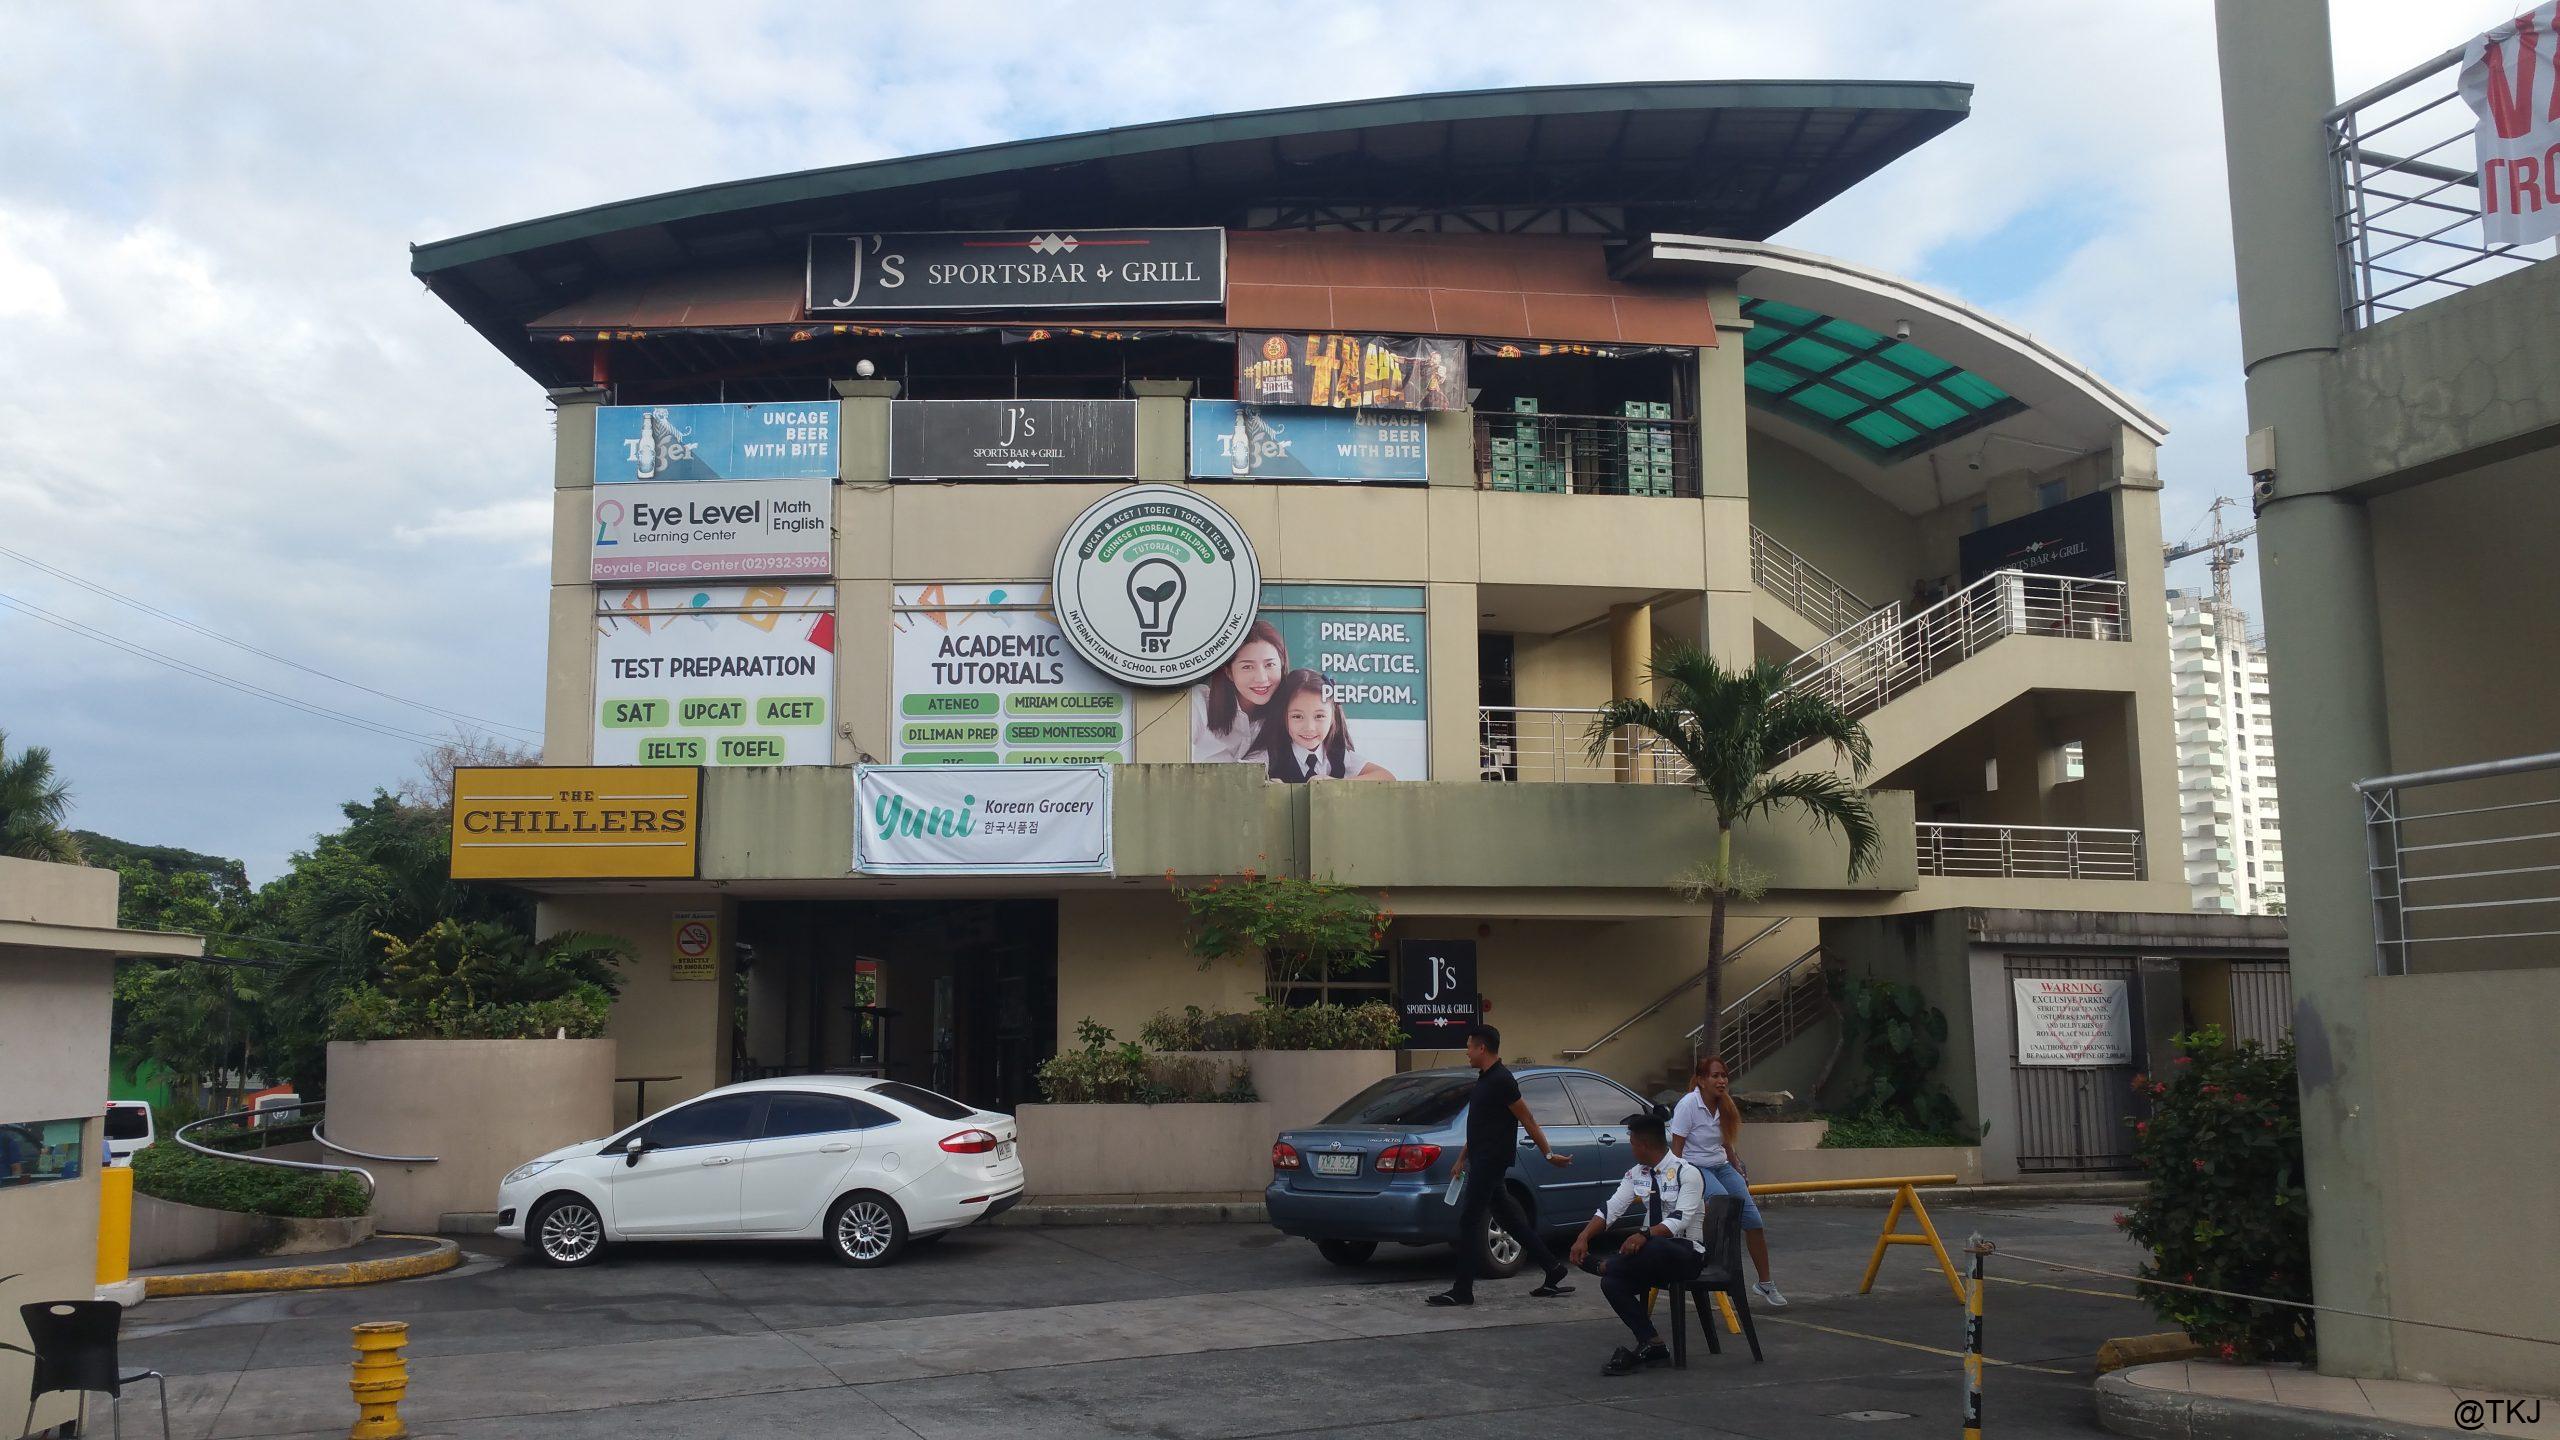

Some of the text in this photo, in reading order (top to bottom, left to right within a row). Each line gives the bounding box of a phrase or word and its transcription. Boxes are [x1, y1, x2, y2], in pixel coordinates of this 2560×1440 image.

[928, 262, 1087, 285] SPORTSBAR
[1122, 262, 1200, 283] GRILL
[1262, 358, 1293, 376] BEER
[763, 412, 828, 425] UNCAGE
[786, 427, 828, 441] BEER
[1379, 430, 1420, 442] BEER
[624, 436, 698, 472] Tger
[744, 442, 828, 457] WITH BITE
[973, 449, 1009, 458] SPORTS
[1010, 448, 1029, 458] BAR
[1039, 449, 1066, 458] GRILL
[1217, 434, 1292, 469] Tger
[1337, 444, 1421, 458] WITH BITE
[633, 500, 760, 531] Eye Level
[773, 501, 811, 513] Math
[773, 517, 824, 533] English
[1084, 506, 1231, 555] UPCAT & ACET TOEIC TOEFL IELTS
[633, 530, 736, 544] Learning Center
[1103, 524, 1211, 559] CHINESE KOREAN FILIPINO
[1133, 542, 1180, 556] TUTORIALS
[2030, 552, 2049, 569] BAR
[2059, 542, 2088, 559] GRILL
[594, 556, 828, 576] Royale Place Center (02)932-3996
[1321, 622, 1410, 643] PREPARE.
[938, 635, 1060, 658] ACADEMIC
[1069, 610, 1244, 674] INTERNATIONAL SCHOOL FOR DEVELOPMENT INC.
[611, 655, 816, 679] TEST PREPARATION
[1321, 653, 1420, 674] PRACTICE.
[931, 662, 1064, 685] TUTORIALS
[1015, 696, 1114, 708] MIRIAM COLLEGE
[1321, 684, 1417, 705] PERFORM.
[616, 702, 814, 722] SAT UPCAT ACET
[928, 699, 979, 710] ATENEO
[909, 728, 998, 741] DILIMAN PREP
[1011, 726, 1117, 738] SEED MONTESSORI
[648, 741, 780, 760] IELTS TOEFL
[559, 791, 594, 802] THE
[985, 798, 1094, 816] Korean Grocery
[463, 809, 687, 834] CHILLERS
[875, 794, 978, 841] Yuni
[984, 821, 1039, 835] 한국식품점
[1424, 956, 1457, 1001] J's
[2041, 982, 2103, 993] WARNING
[1406, 1003, 1475, 1015] SPORTS BAR & GRILL
[2032, 996, 2113, 1004] EXCLUSIVE PARKING
